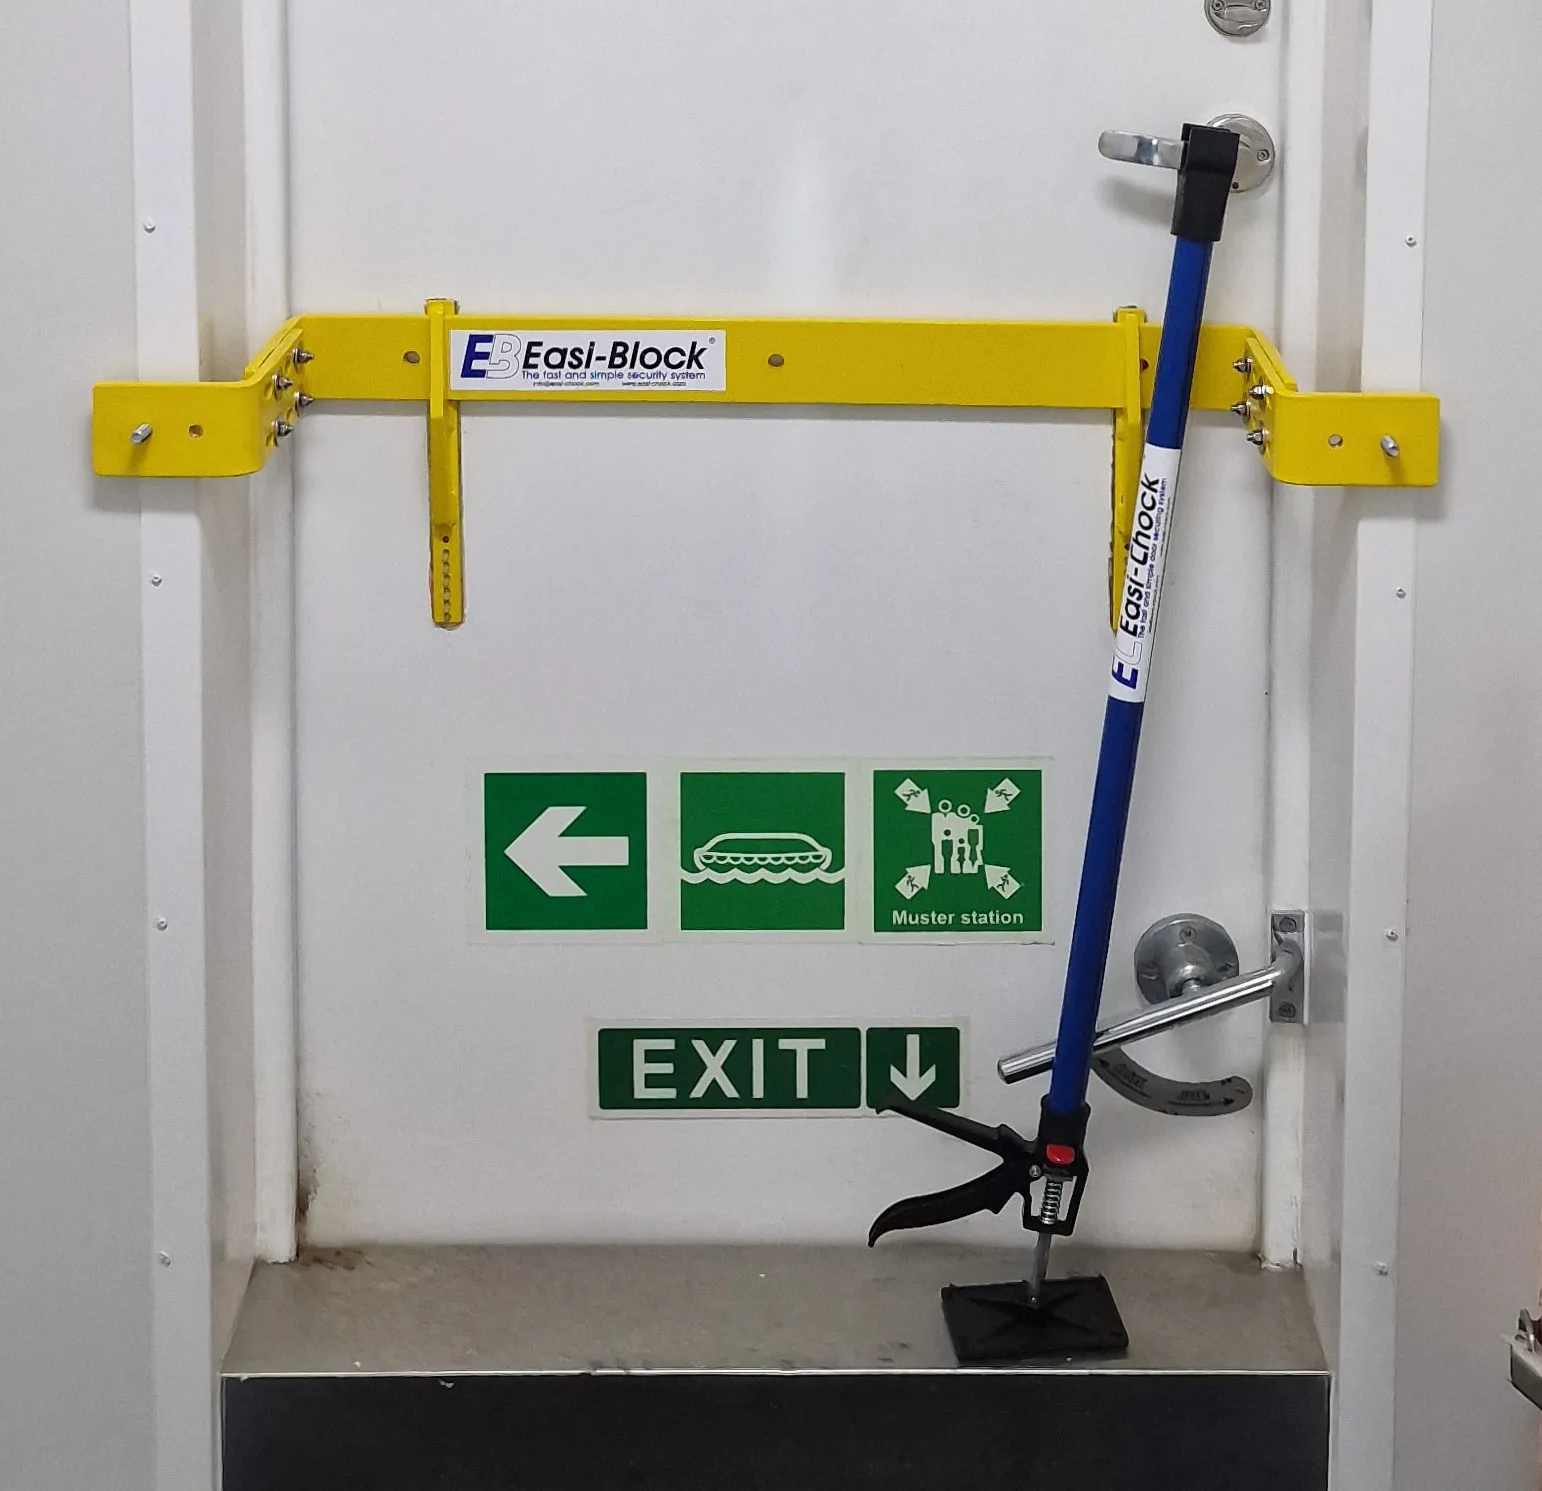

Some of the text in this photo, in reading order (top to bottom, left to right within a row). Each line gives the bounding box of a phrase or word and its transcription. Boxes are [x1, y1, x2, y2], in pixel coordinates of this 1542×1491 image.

[522, 341, 708, 370] Easi-Block
[522, 370, 706, 381] The fast and simple security system
[1120, 471, 1159, 637] Easi-Chock
[892, 910, 1024, 925] Muster station
[632, 1038, 826, 1099] EXIT
